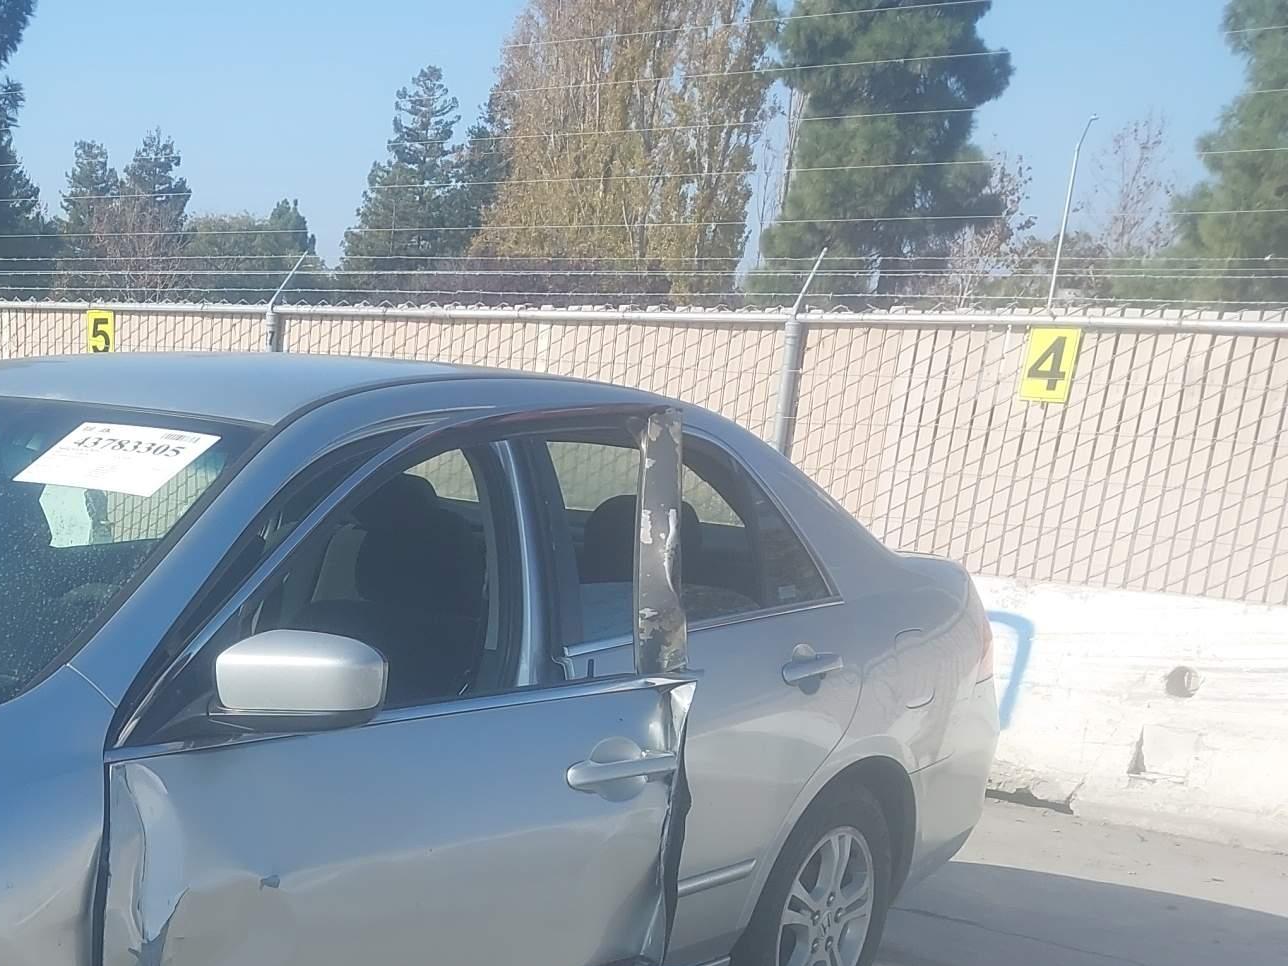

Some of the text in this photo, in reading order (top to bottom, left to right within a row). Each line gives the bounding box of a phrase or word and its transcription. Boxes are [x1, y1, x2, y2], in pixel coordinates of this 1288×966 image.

[92, 318, 110, 353] 5
[1027, 336, 1067, 391] 4
[73, 436, 187, 458] 43783305
